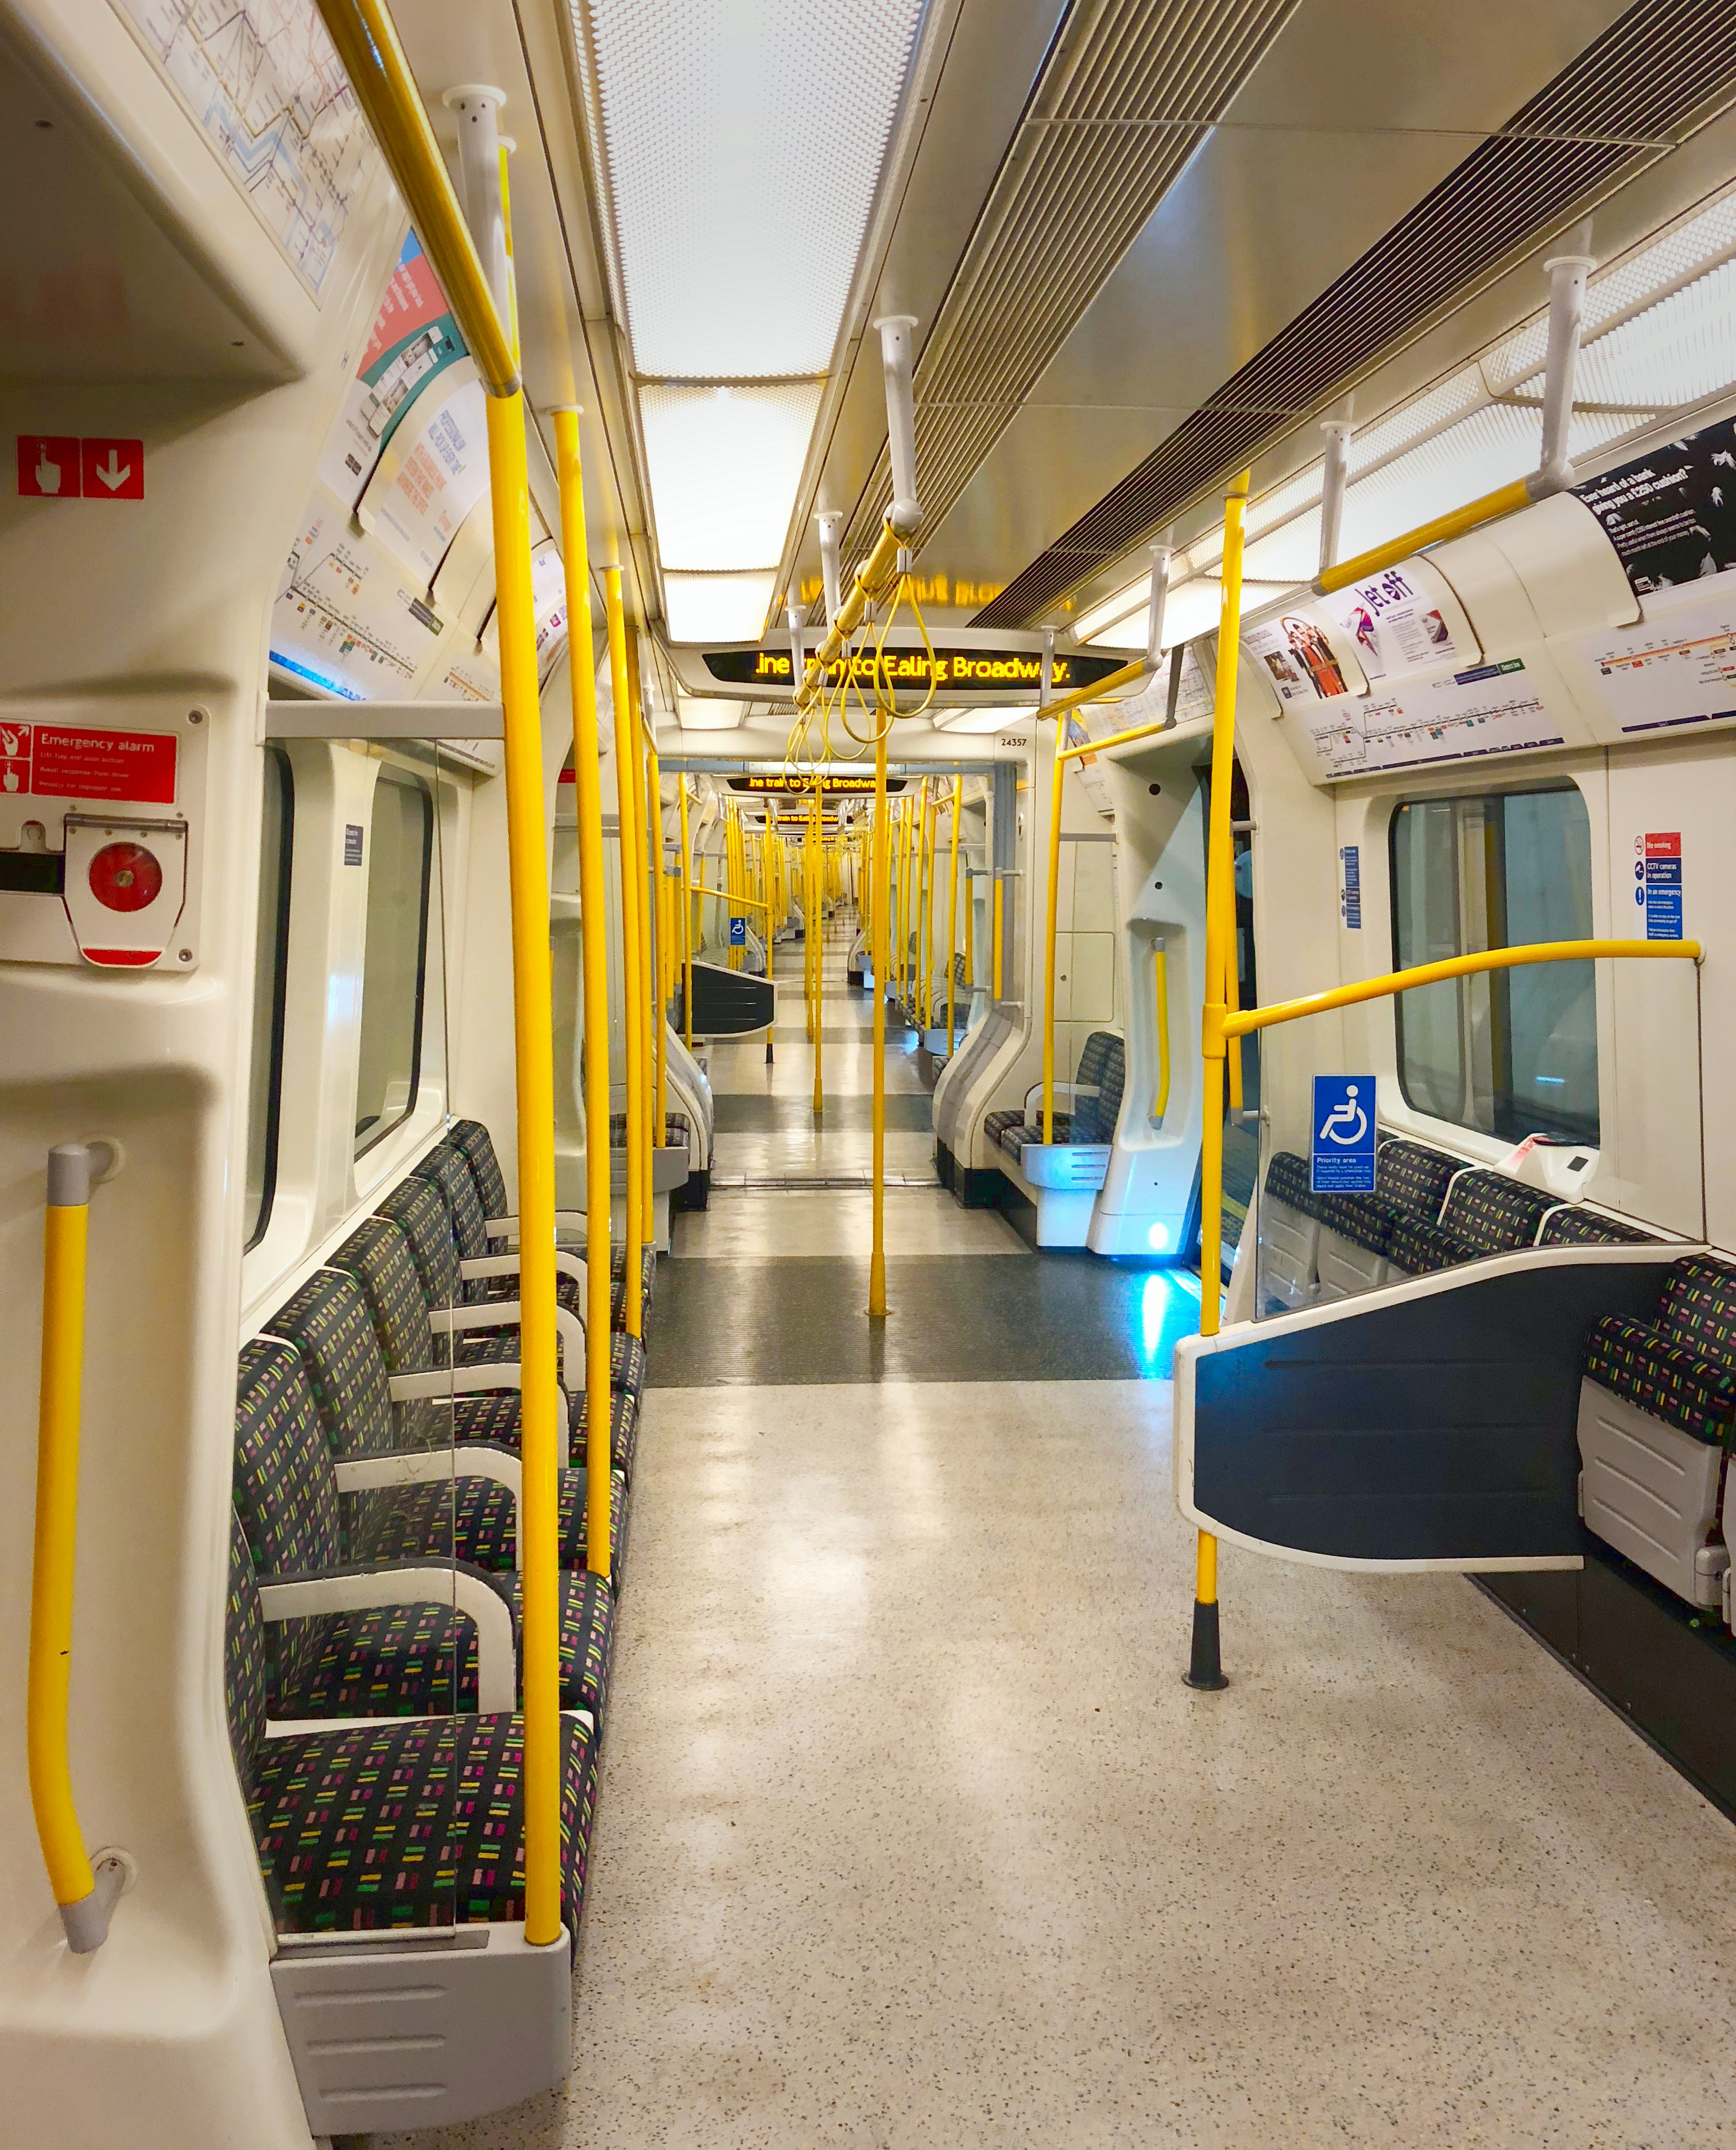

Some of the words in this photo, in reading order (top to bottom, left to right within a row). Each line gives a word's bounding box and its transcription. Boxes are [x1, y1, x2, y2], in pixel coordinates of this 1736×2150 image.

[1619, 478, 1629, 488] of
[1627, 478, 1636, 486] a
[1630, 468, 1656, 483] bank
[1579, 490, 1600, 503] Ever
[1592, 501, 1616, 515] giving
[1613, 495, 1629, 508] you
[1626, 492, 1634, 501] a
[1630, 483, 1654, 498] £250
[1652, 468, 1688, 490] cushion?
[1595, 482, 1622, 497] heard
[1382, 571, 1414, 601] off
[884, 655, 948, 681] Ealing
[954, 657, 1071, 682] Broadwy.
[41, 733, 114, 751] Emergency
[118, 741, 154, 752] alarm
[789, 778, 801, 787] to
[832, 778, 876, 788] Broadwa
